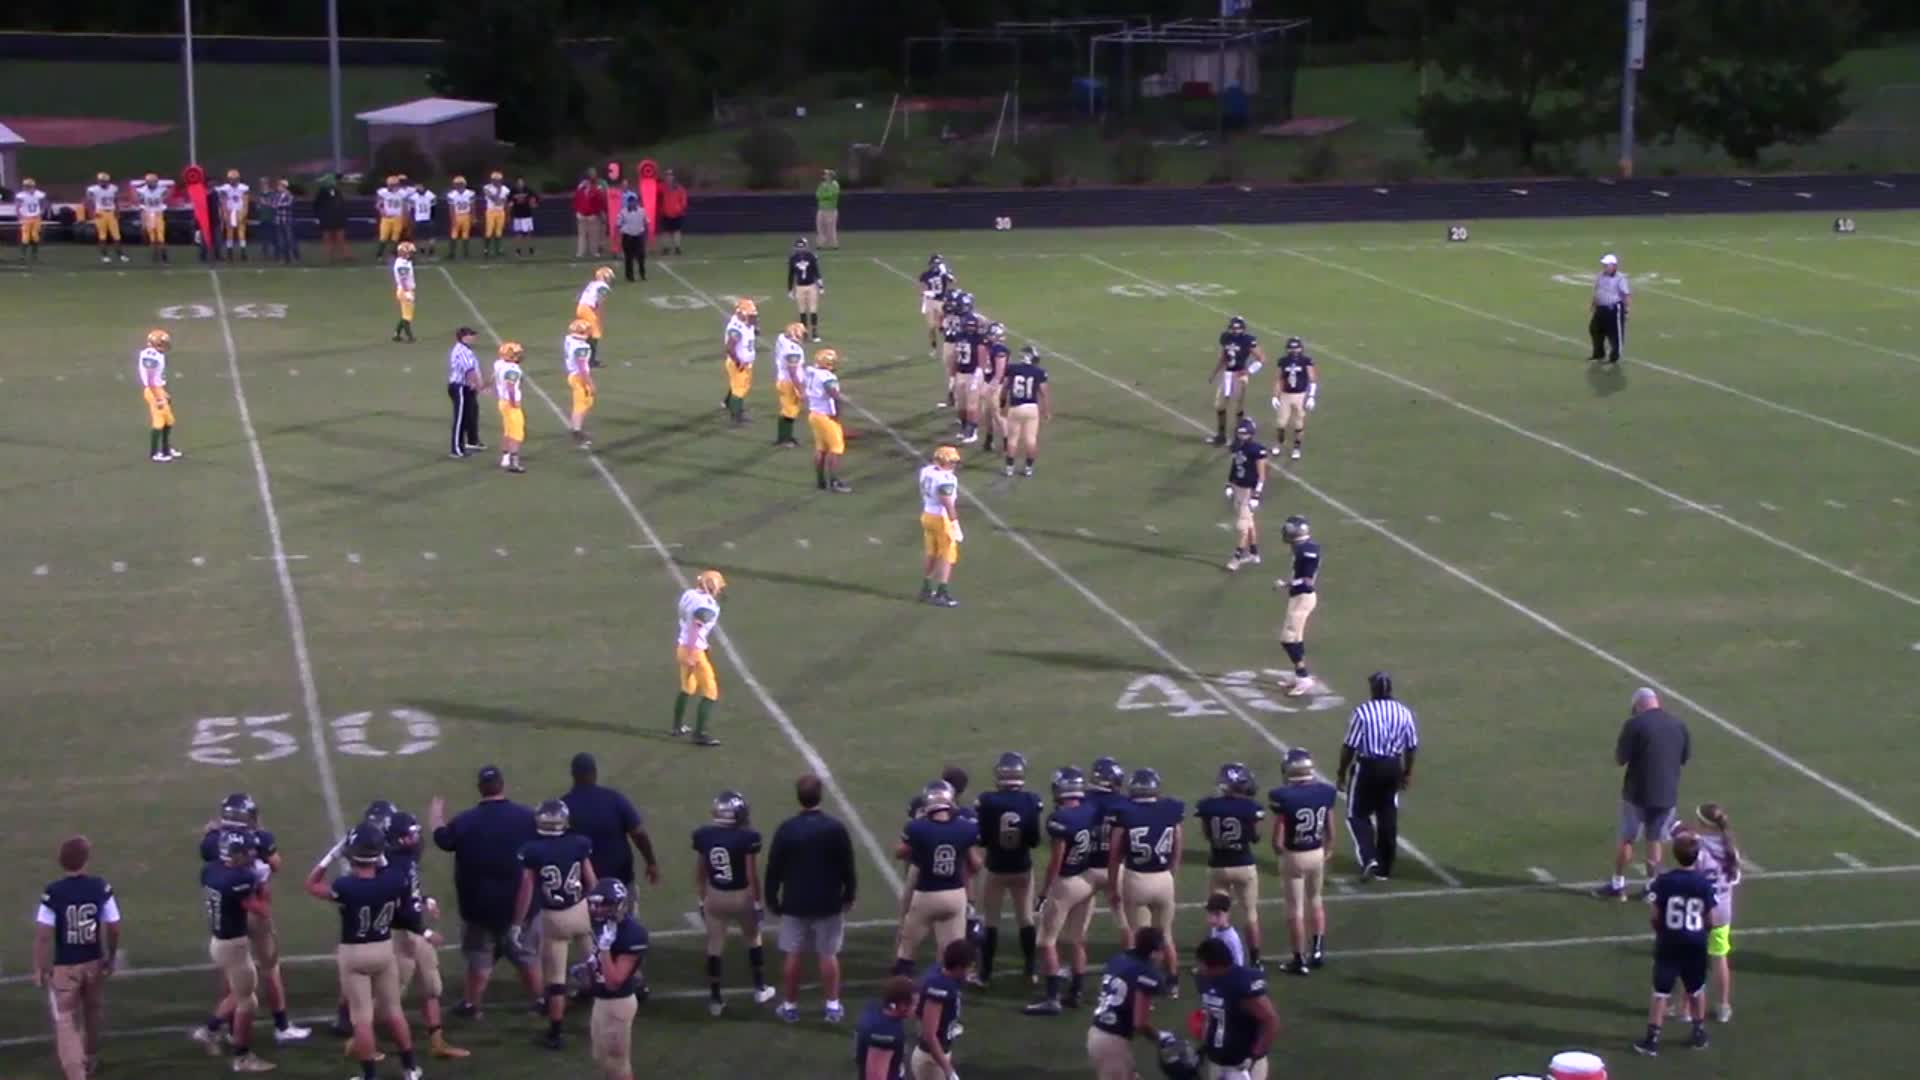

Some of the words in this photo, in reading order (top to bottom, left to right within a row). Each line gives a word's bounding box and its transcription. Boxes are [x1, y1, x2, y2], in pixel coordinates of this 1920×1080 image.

[995, 217, 1012, 230] 30
[1450, 227, 1468, 241] 20
[1012, 374, 1035, 401] 61
[188, 709, 441, 764] 50
[1128, 826, 1175, 865] 54
[540, 862, 584, 904] 24
[356, 901, 396, 937] 14
[1665, 896, 1704, 931] 68
